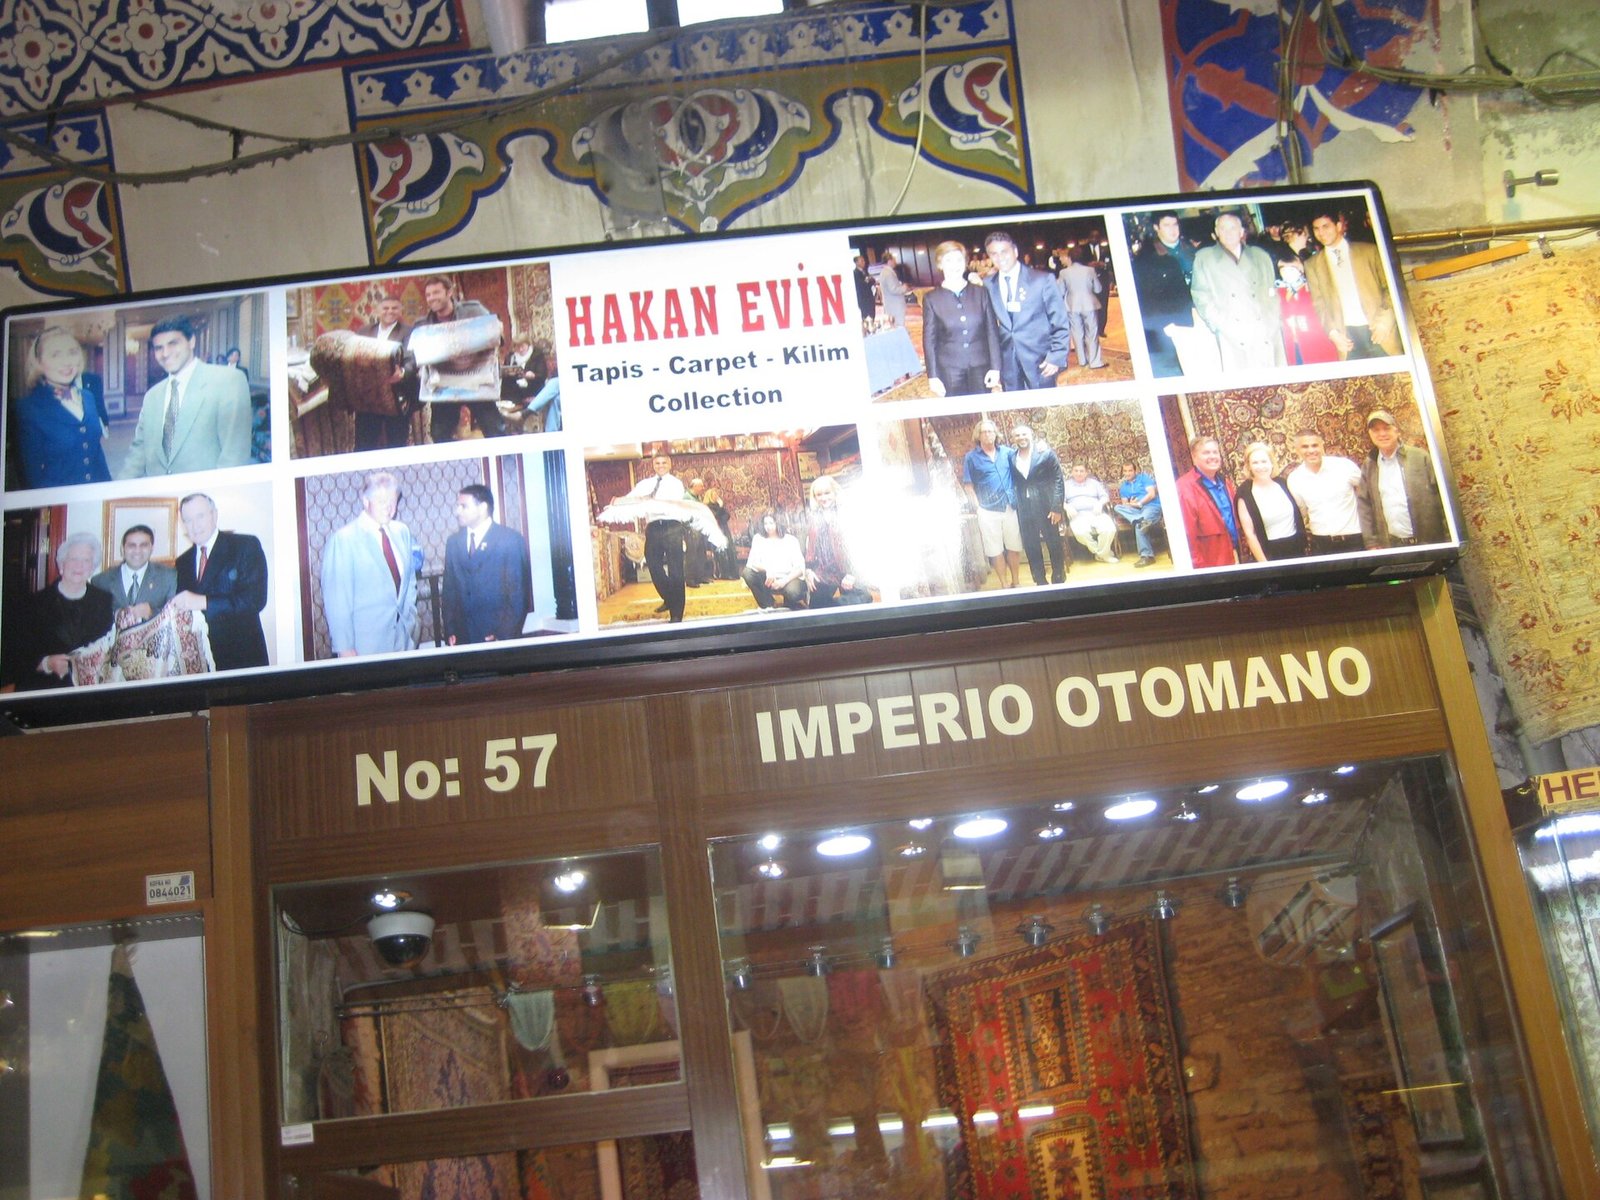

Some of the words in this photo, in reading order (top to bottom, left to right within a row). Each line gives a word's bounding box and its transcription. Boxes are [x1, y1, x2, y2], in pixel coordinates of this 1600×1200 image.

[565, 285, 719, 347] HAKAN
[736, 262, 846, 332] EVİN
[572, 360, 643, 385] Tapis
[669, 350, 758, 376] Carpet
[783, 344, 850, 365] Kilim
[649, 386, 783, 413] Collection
[756, 682, 1034, 764] IMPERIO
[1055, 646, 1372, 728] OTOMANO
[355, 750, 461, 806] No:
[484, 733, 558, 793] 57
[1542, 770, 1600, 804] HE
[149, 885, 191, 899] 0844021
